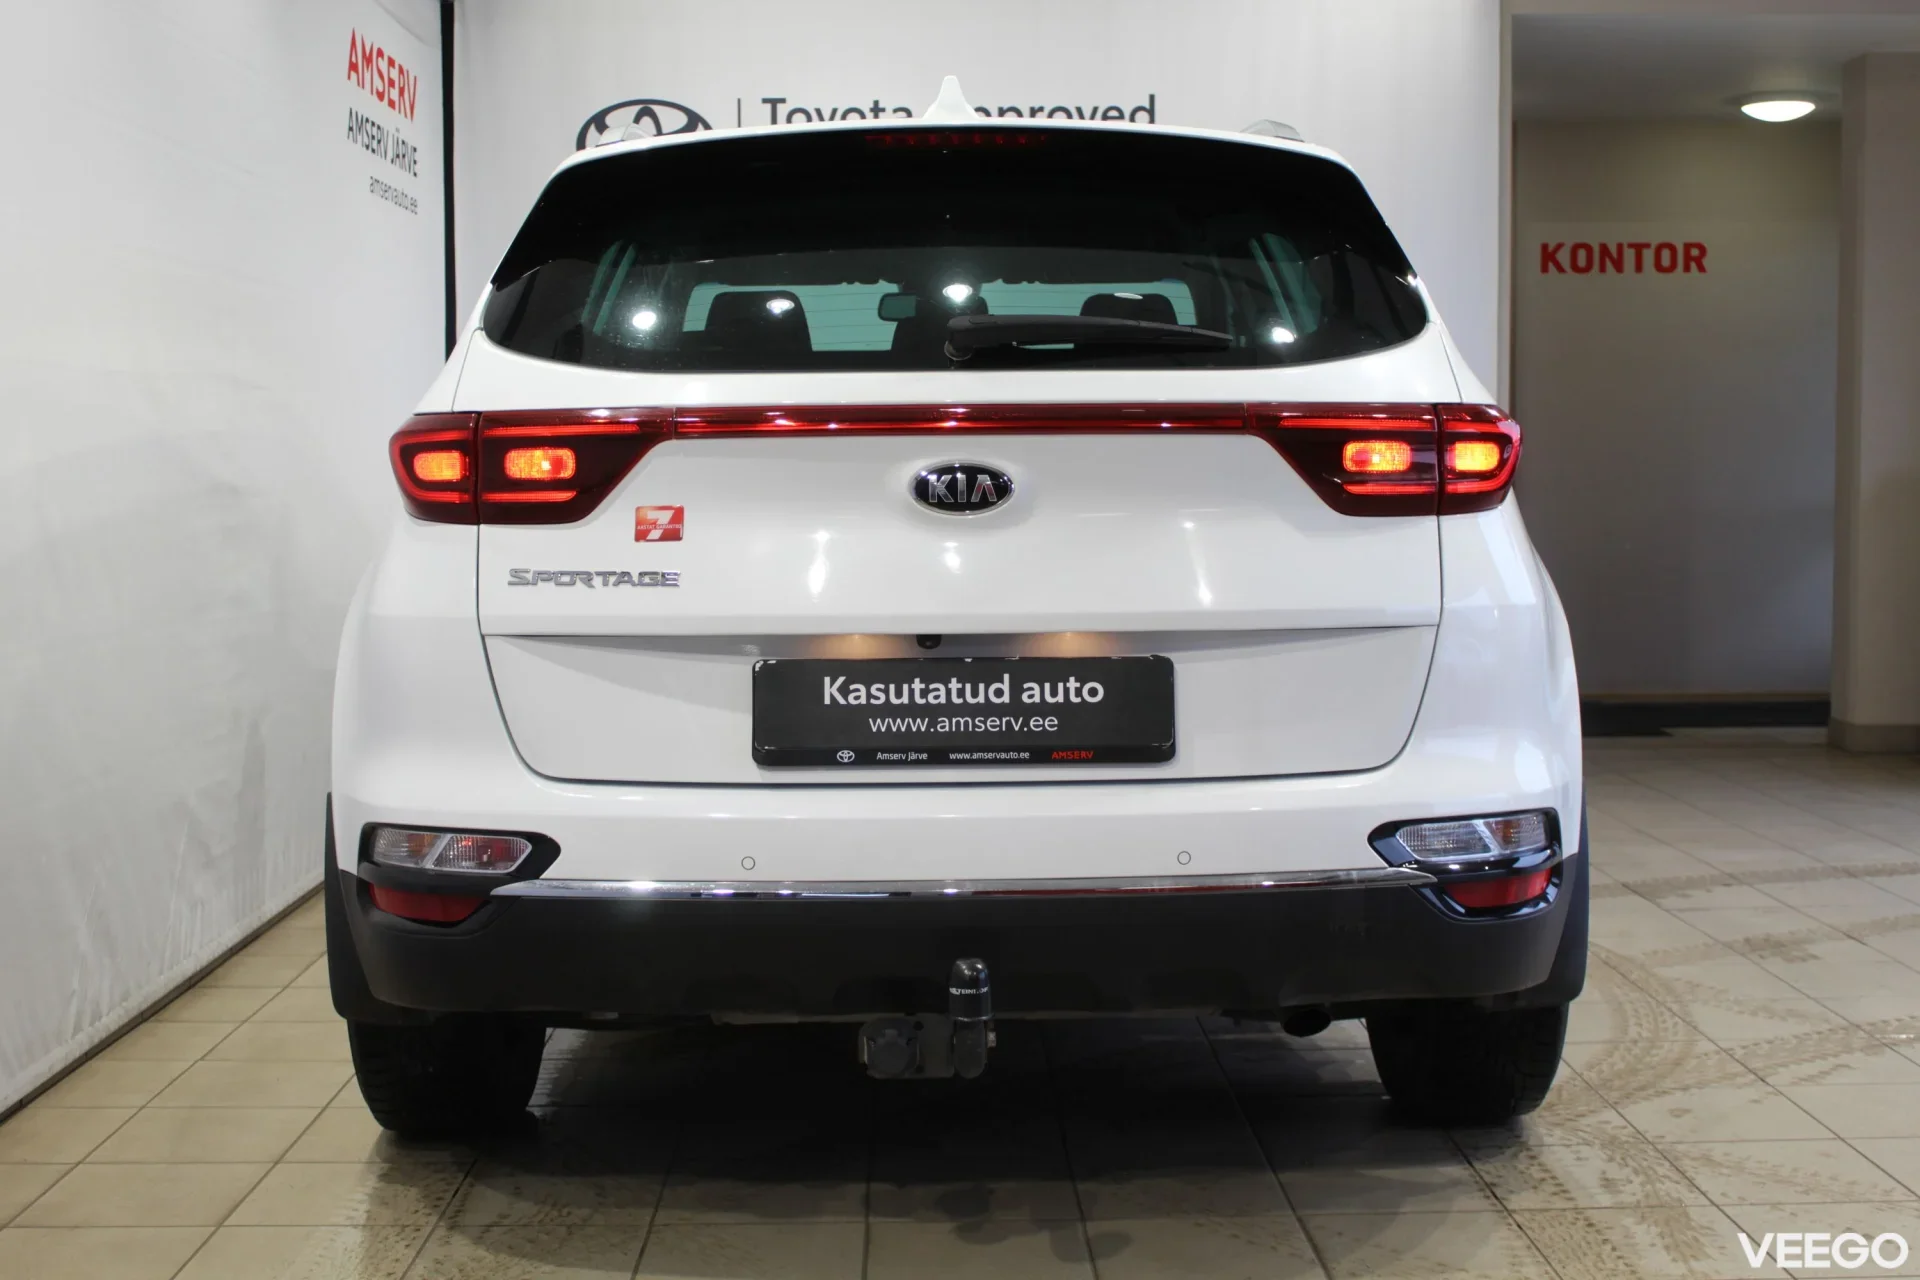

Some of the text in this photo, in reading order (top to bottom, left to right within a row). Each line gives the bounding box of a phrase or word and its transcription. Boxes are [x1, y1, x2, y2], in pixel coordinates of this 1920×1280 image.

[347, 27, 417, 122] AMSERV
[347, 107, 418, 178] AMSERV JÄRVE
[370, 175, 418, 215] amservauto.ee
[1540, 242, 1708, 274] KONTOR
[928, 474, 998, 503] KIA
[646, 509, 675, 540] 7
[507, 568, 681, 589] SPORTAGE
[823, 673, 1105, 705] Kasutatud auto
[868, 715, 1059, 733] www.amserv.ee
[876, 750, 1094, 762] Amserv Järve www.amservauto.ee AMSERV
